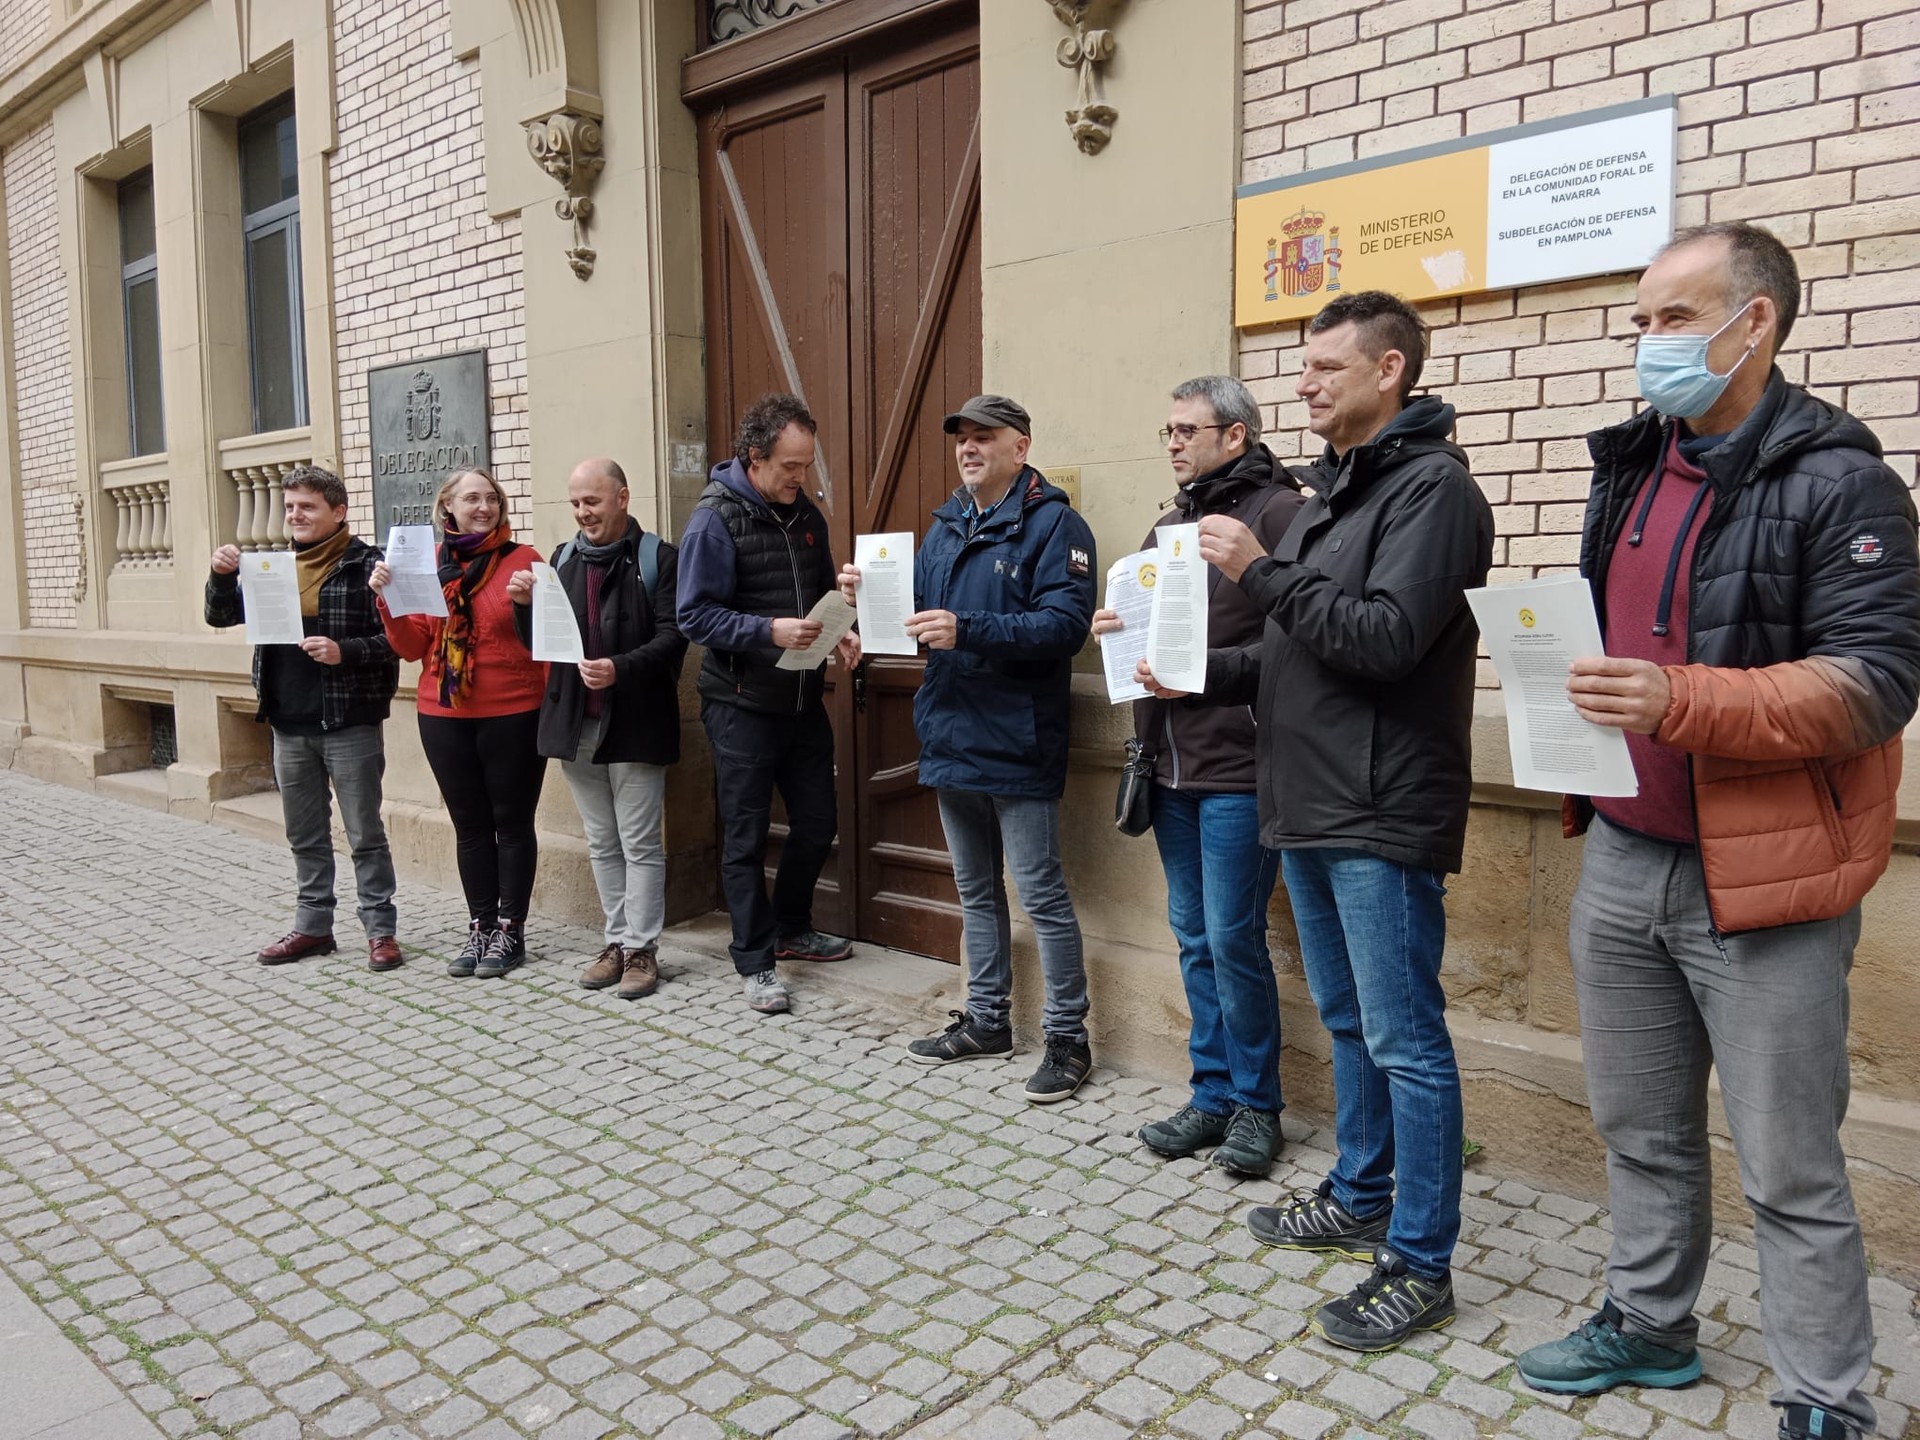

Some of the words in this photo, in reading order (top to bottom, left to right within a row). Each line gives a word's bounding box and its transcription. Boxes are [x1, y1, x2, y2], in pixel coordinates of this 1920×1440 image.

[1502, 189, 1516, 199] EN
[1519, 186, 1532, 196] LA
[1534, 174, 1597, 194] COMUNIDAD
[1600, 167, 1636, 181] FORAL
[1639, 163, 1654, 174] DE
[1510, 163, 1576, 184] DELEGACIÓN
[1579, 160, 1593, 171] DE
[1596, 150, 1647, 168] DEFENSA
[1551, 187, 1600, 204] NAVARRA
[1360, 209, 1446, 237] MINISTERIO
[1498, 217, 1585, 240] SUBDELEGACIÓN
[1588, 214, 1603, 225] DE
[1605, 206, 1657, 222] DEFENSA
[1538, 237, 1552, 247] EN
[1554, 227, 1612, 245] PAMPLONA
[1360, 239, 1379, 255] DE
[1383, 226, 1454, 251] DEFENSA
[379, 445, 478, 476] DELEGACION
[418, 481, 433, 496] DE
[1071, 549, 1089, 565] HH
